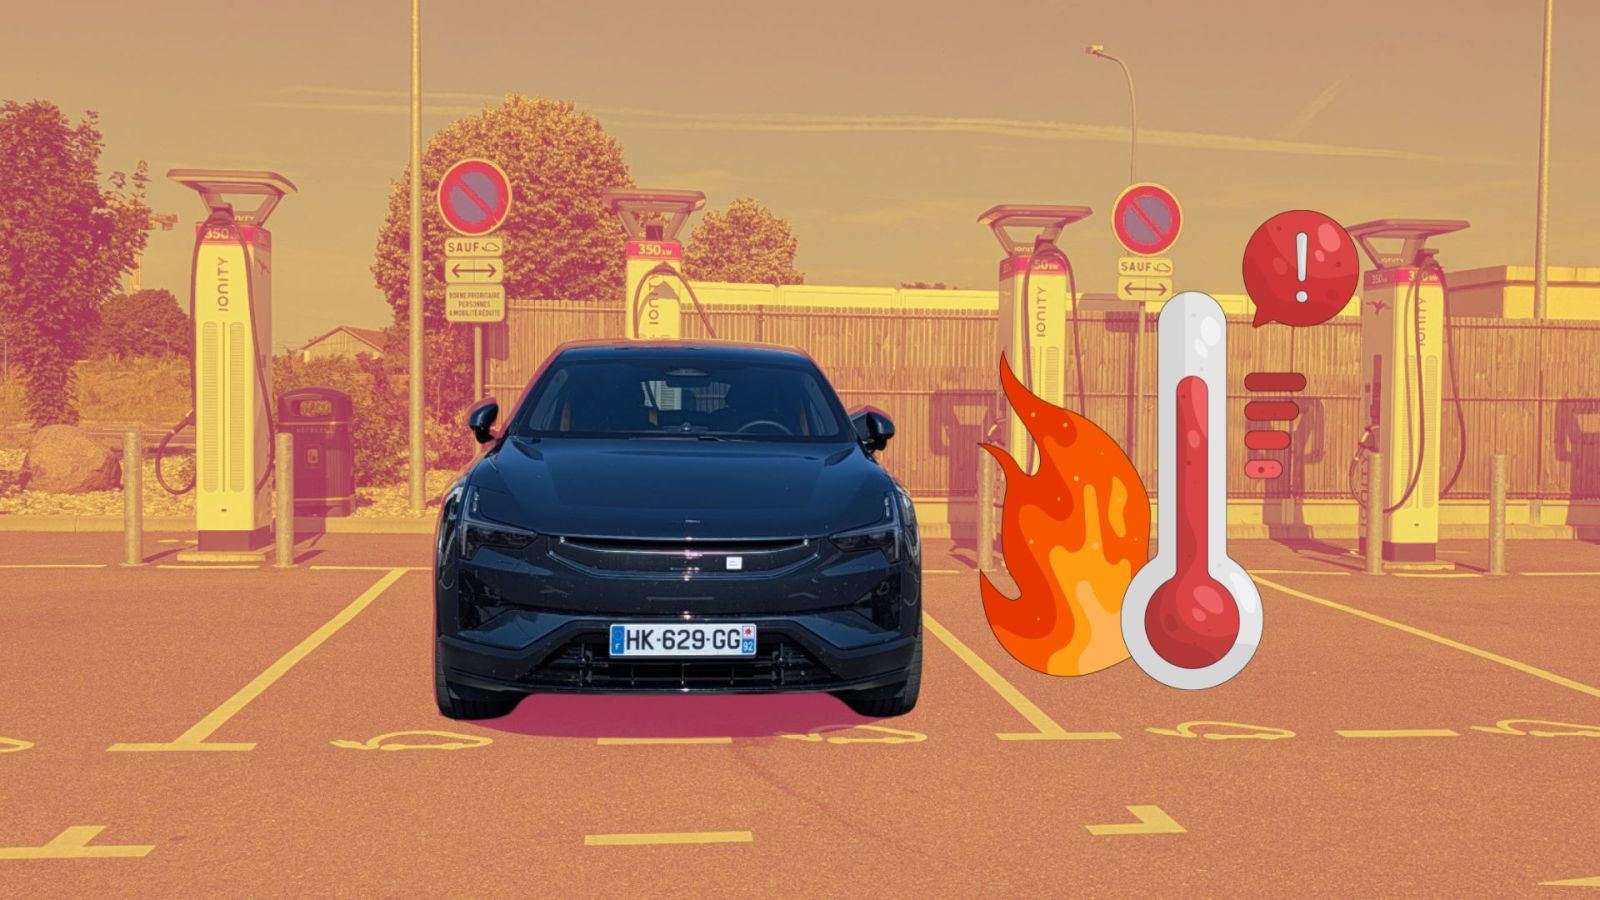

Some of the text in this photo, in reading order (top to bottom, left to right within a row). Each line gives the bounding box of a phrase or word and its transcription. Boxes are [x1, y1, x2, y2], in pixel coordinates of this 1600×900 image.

[448, 242, 479, 252] SAUF
[639, 244, 661, 255] 350
[1121, 261, 1152, 272] SAUF
[1408, 270, 1428, 281] 30
[217, 257, 229, 311] IONITY
[1036, 286, 1047, 337] IONITY
[743, 641, 753, 651] 92
